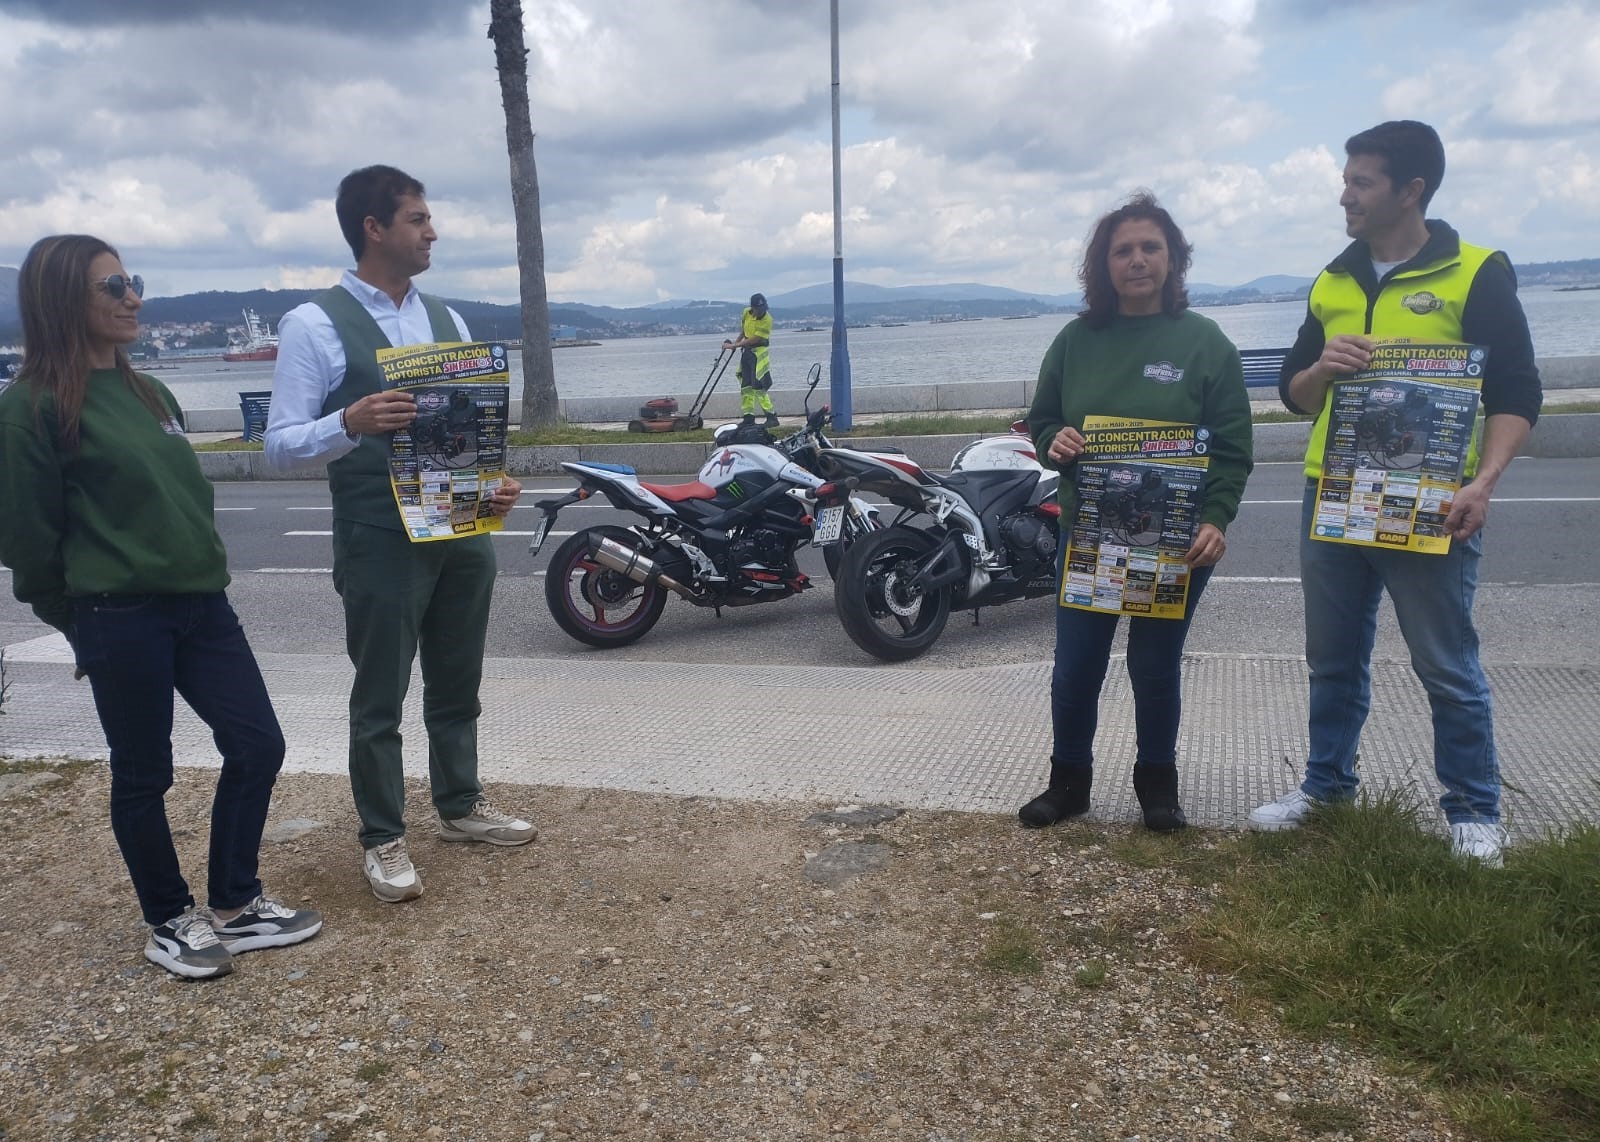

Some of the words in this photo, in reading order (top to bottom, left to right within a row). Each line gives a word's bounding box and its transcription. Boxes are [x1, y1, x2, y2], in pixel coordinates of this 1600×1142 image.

[383, 363, 395, 373] XI
[396, 346, 490, 369] CONCENTRACIÓN
[385, 366, 443, 382] MOTORISTA
[1085, 433, 1096, 443] XI
[1098, 428, 1194, 442] CONCENTRACIÓN
[1085, 443, 1140, 454] MOTORISTA
[821, 508, 842, 524] 6157
[454, 522, 475, 532] GADIS
[1379, 533, 1407, 543] GADIS
[1125, 603, 1151, 611] GADIS
